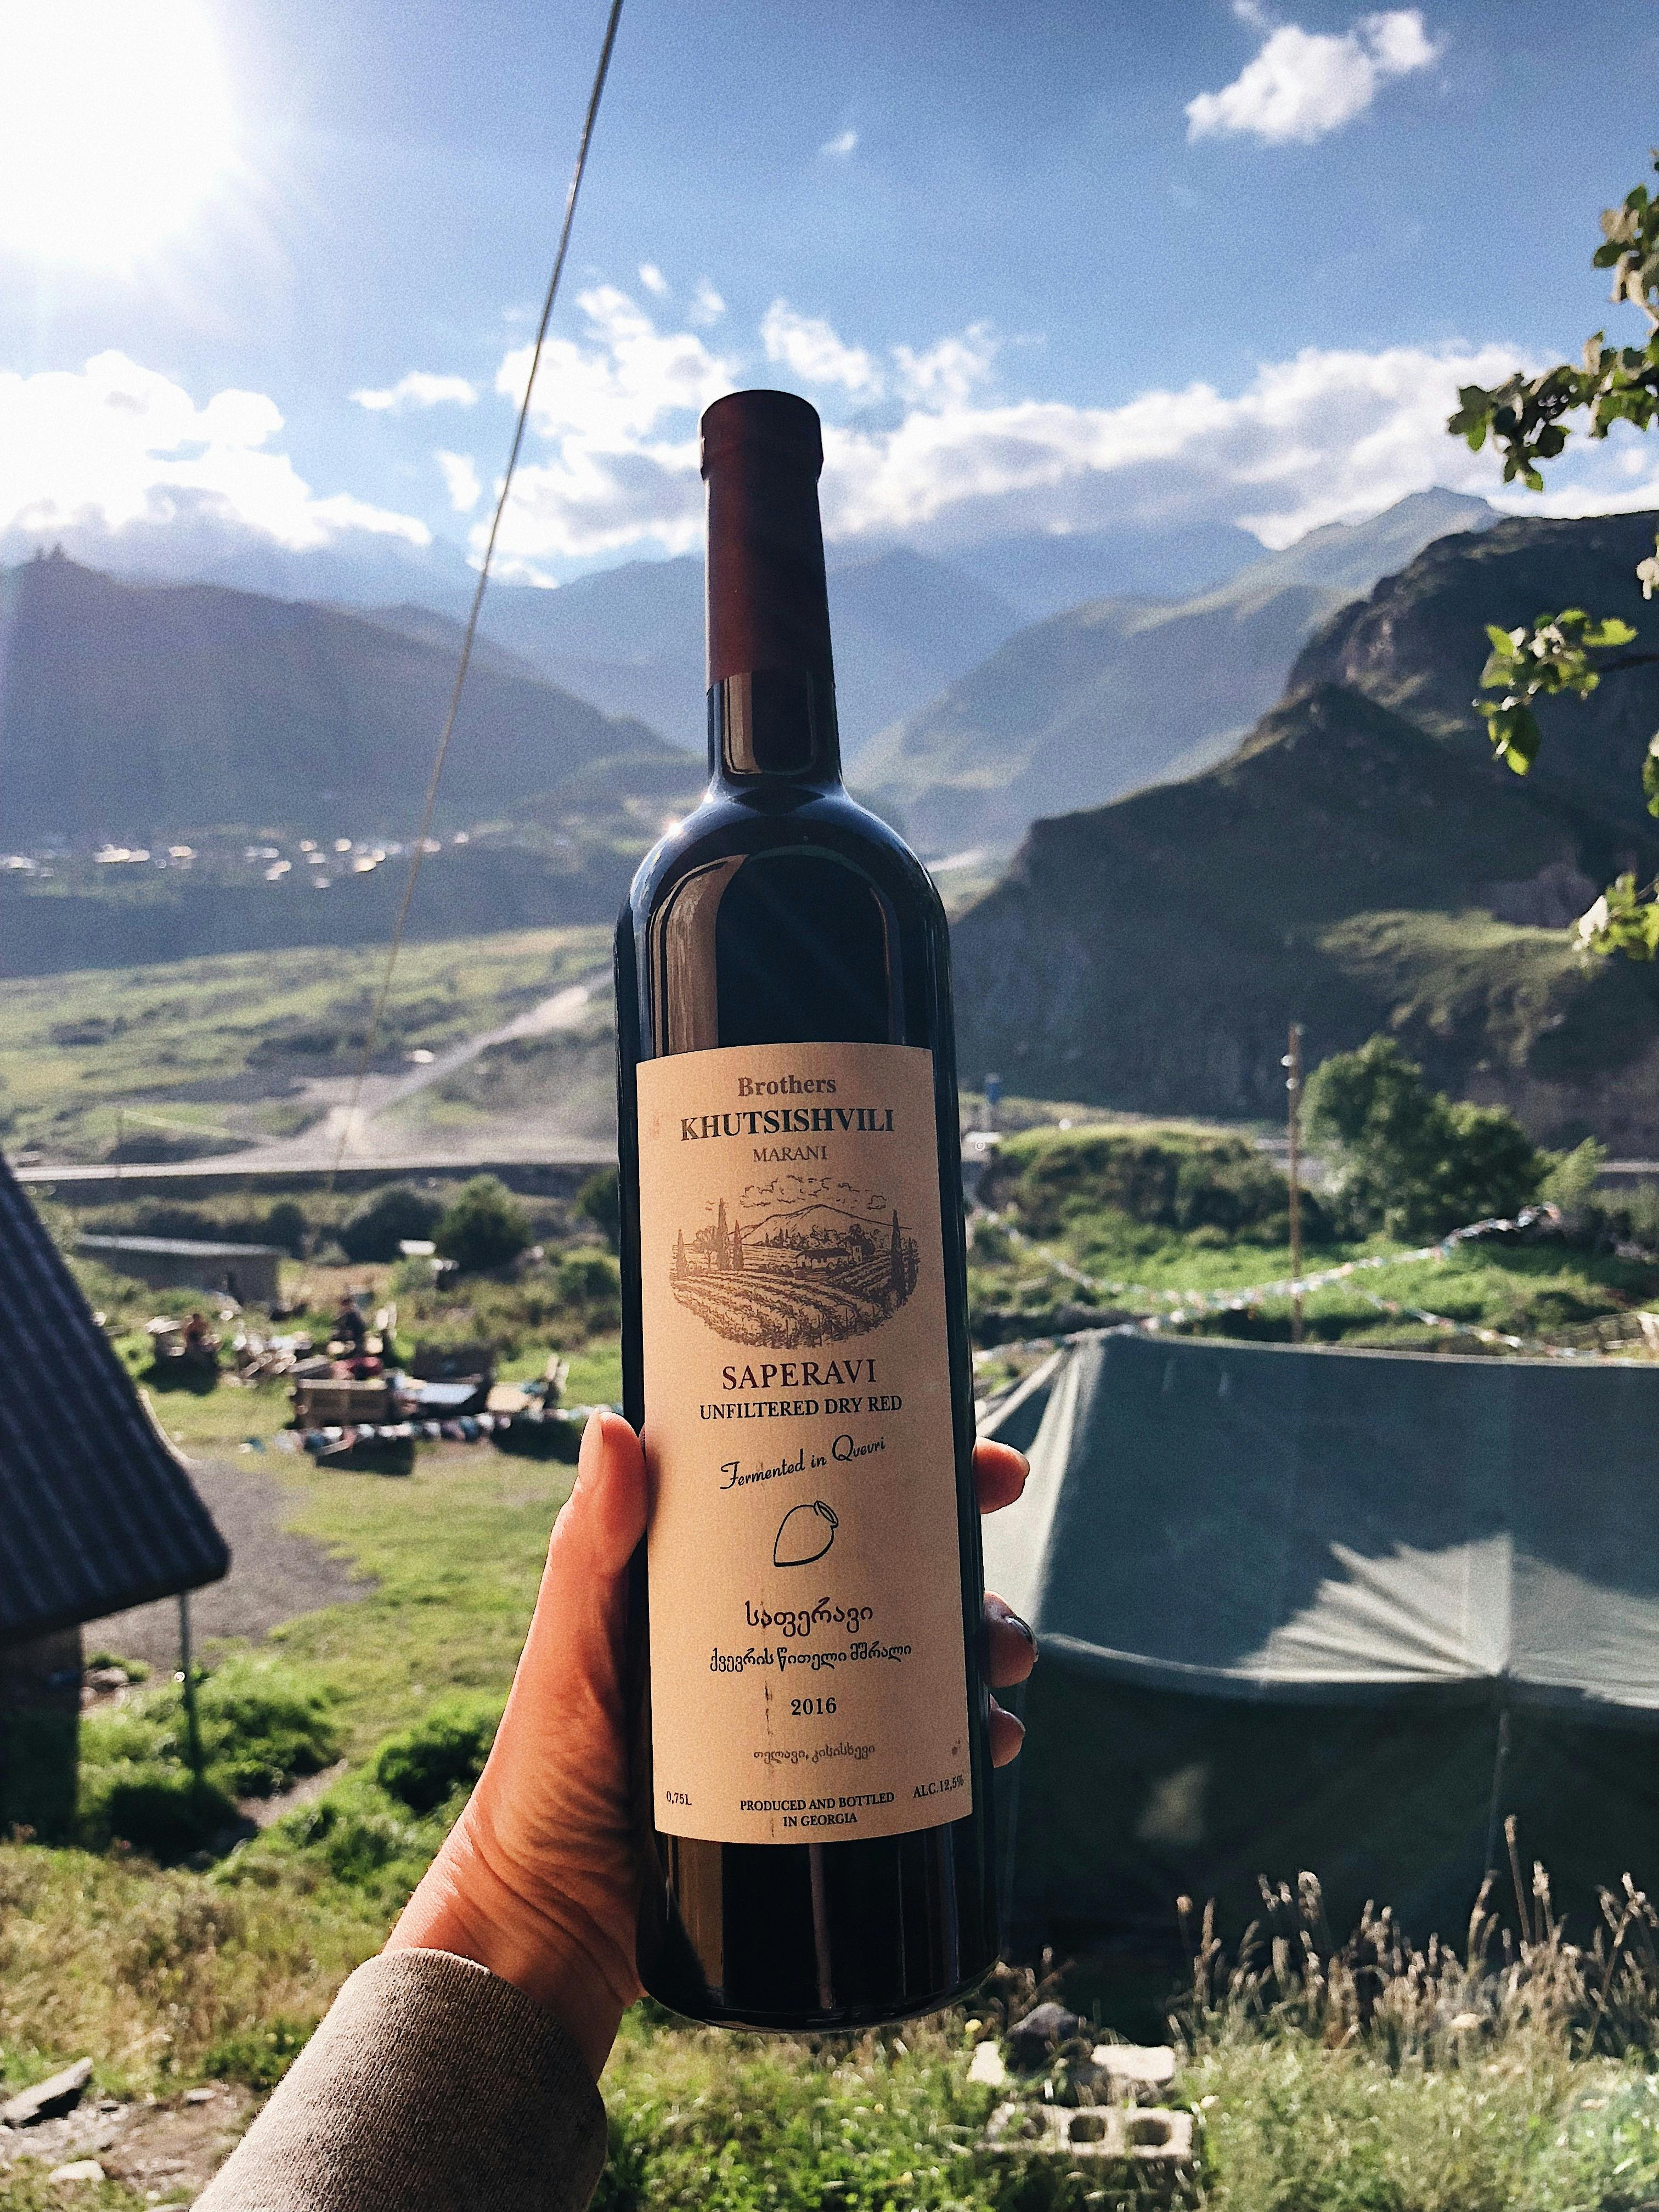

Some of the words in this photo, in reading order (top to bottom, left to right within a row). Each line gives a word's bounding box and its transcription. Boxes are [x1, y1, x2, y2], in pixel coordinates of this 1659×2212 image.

[737, 1075, 837, 1097] Brothers
[680, 1108, 895, 1141] KHUTSISHVILI
[753, 1145, 828, 1163] MARANI
[722, 1359, 877, 1390] SAPERAVI
[699, 1400, 819, 1420] UNFILTERED
[824, 1397, 863, 1415] DRY
[867, 1395, 903, 1412] RED
[719, 1448, 805, 1489] Fermented
[810, 1454, 827, 1469] in
[832, 1435, 885, 1462] Quevri
[744, 1596, 873, 1637] საფერავი
[710, 1647, 774, 1672] ქვევრის
[776, 1646, 847, 1672] წითელი
[850, 1640, 912, 1662] მშრალი
[790, 1697, 837, 1716] 2016
[666, 1791, 692, 1805] 0,75L
[740, 1800, 806, 1811] PRODUCED
[808, 1797, 836, 1810] AND
[838, 1792, 895, 1808] BOTTLED
[783, 1816, 798, 1827] IN
[800, 1813, 857, 1826] GEORGIA
